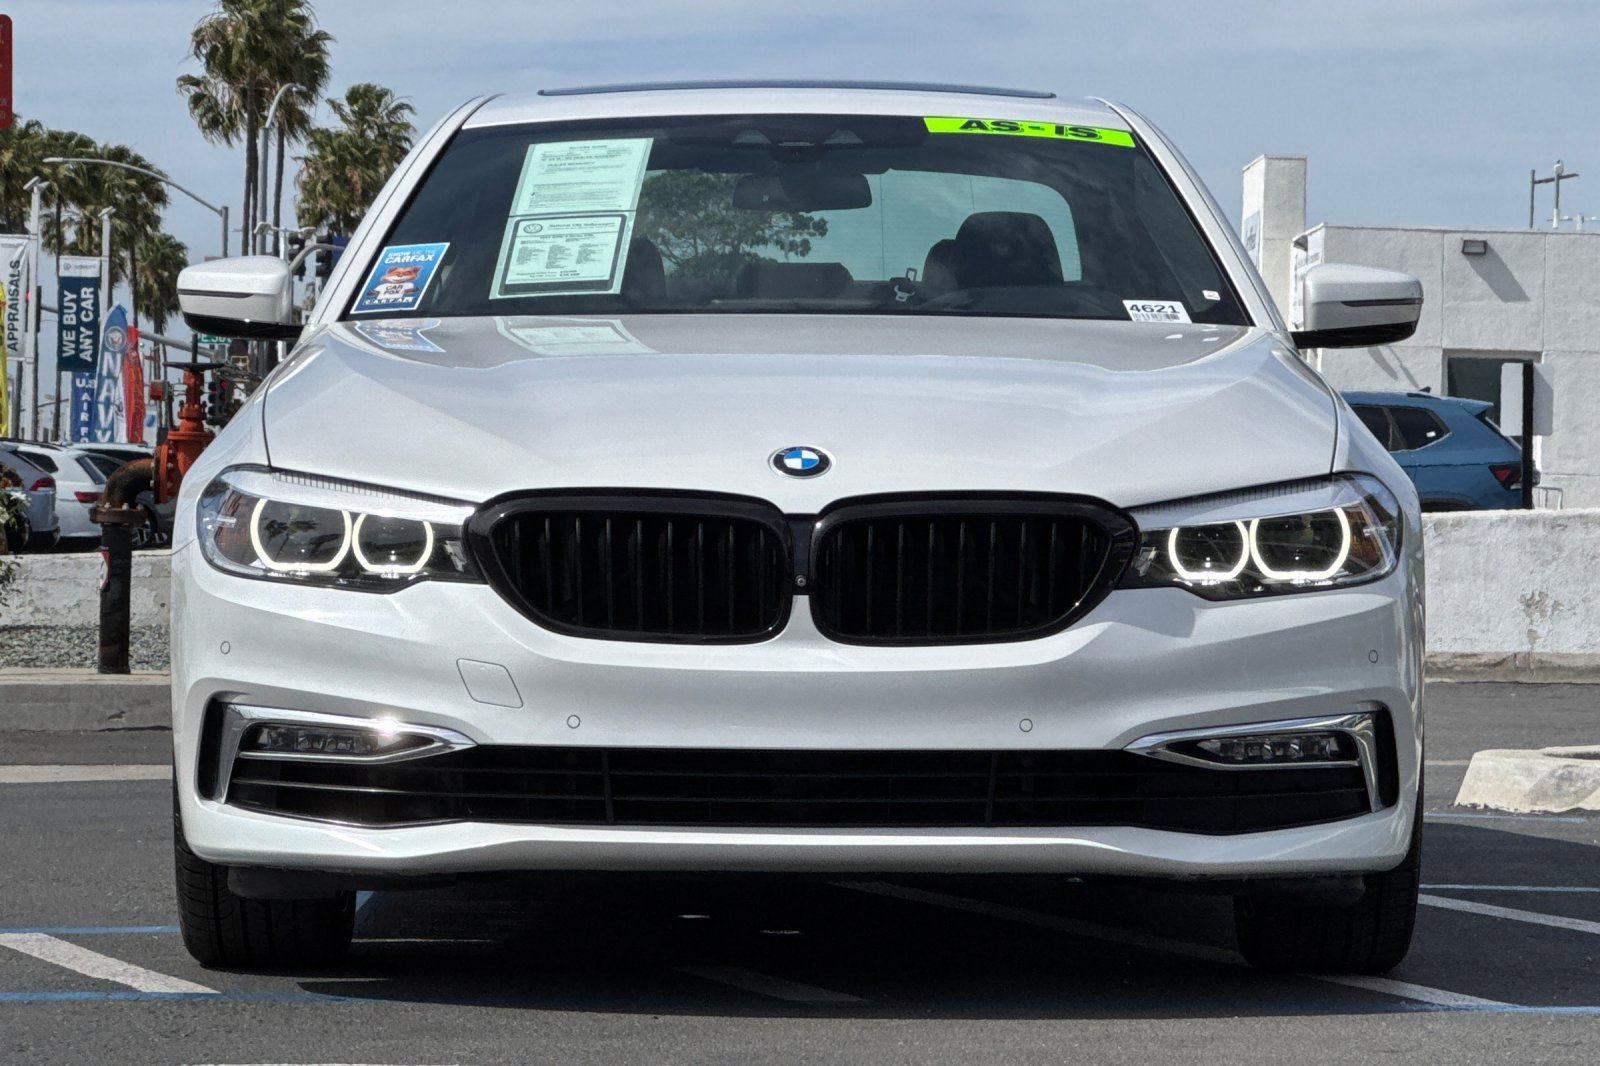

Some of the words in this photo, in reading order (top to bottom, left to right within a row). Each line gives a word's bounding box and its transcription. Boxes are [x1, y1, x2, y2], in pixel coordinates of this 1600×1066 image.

[384, 254, 434, 264] CARFAX
[6, 259, 21, 352] APPRAISALS
[62, 290, 78, 326] BUY
[80, 286, 95, 323] CAR
[1129, 304, 1180, 314] 4621
[62, 331, 77, 358] WE
[79, 324, 93, 362] ANY
[80, 392, 91, 421] AIR
